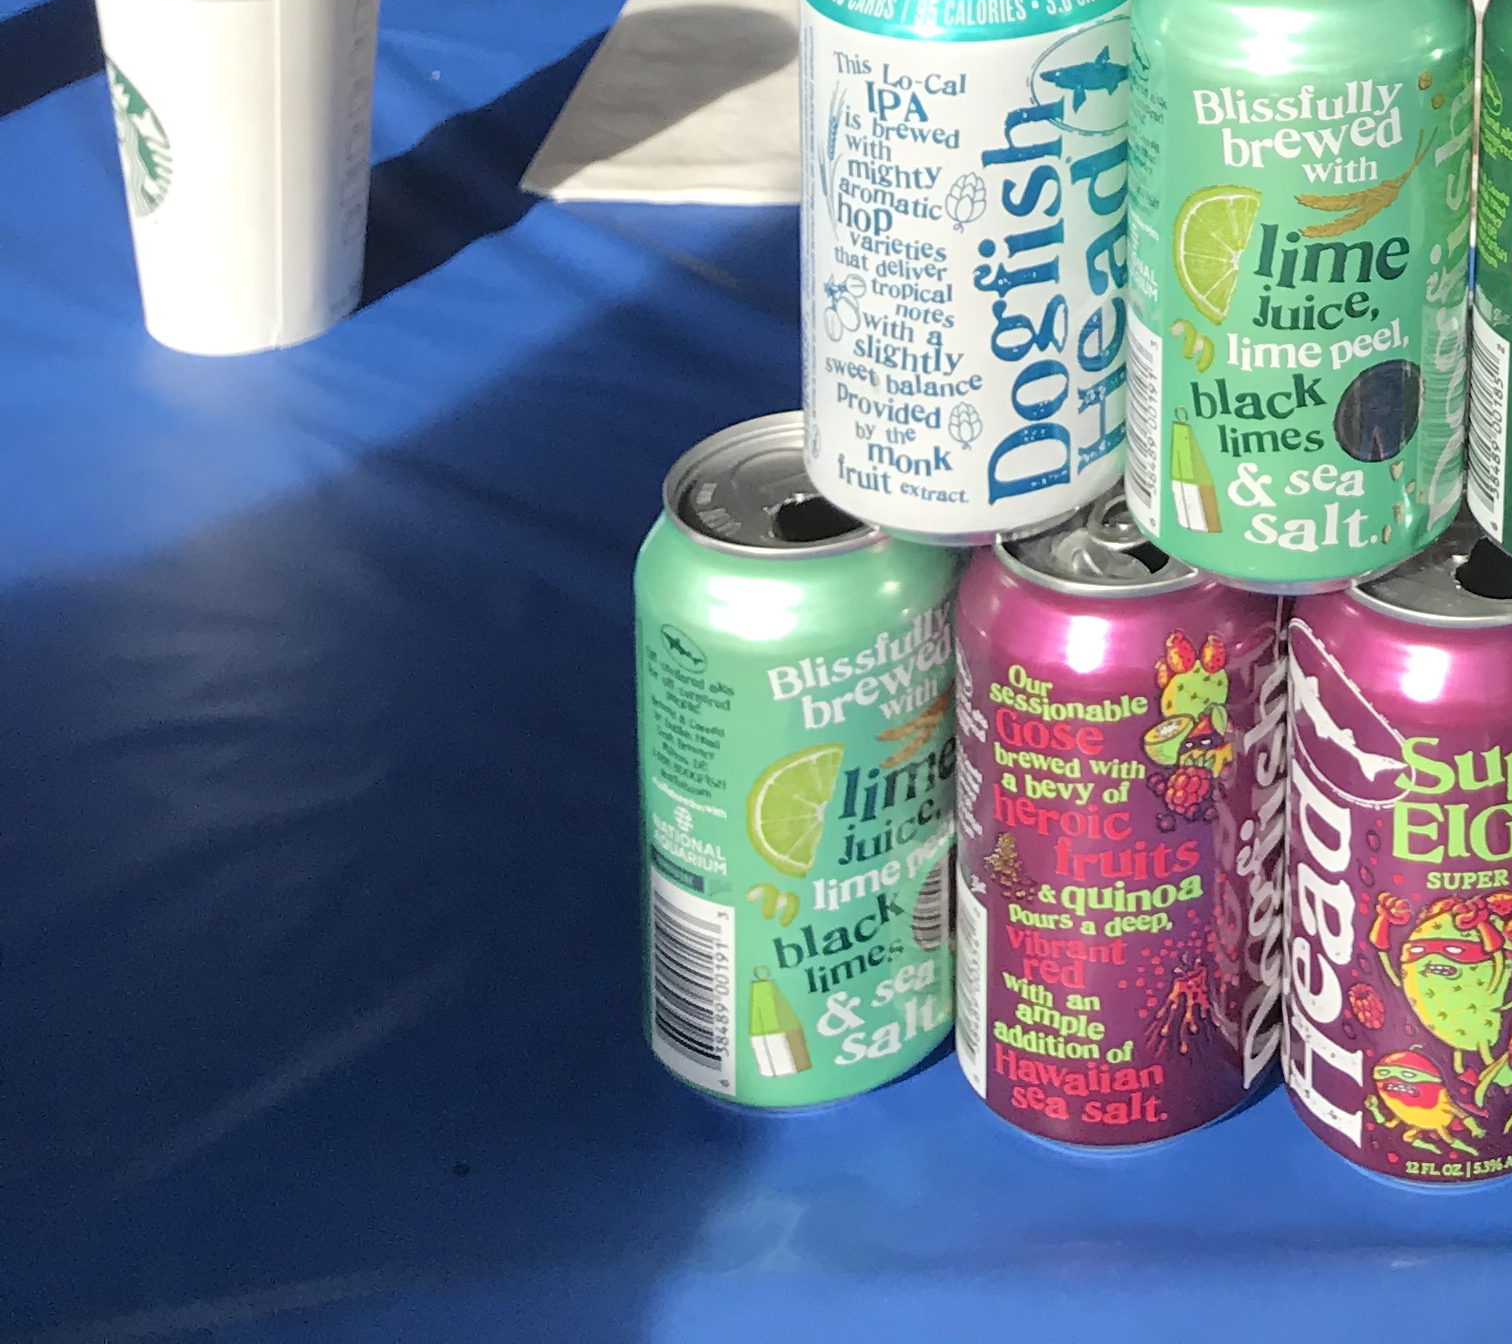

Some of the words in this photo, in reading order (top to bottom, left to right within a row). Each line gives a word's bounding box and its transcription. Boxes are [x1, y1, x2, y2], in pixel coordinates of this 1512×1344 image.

[917, 1, 938, 26] 95
[833, 51, 872, 75] This
[882, 63, 967, 96] Lo-Cal
[866, 80, 929, 123] IPA
[1192, 78, 1404, 126] Blissfully
[844, 133, 893, 162] with
[872, 117, 961, 150] brewed
[1222, 107, 1404, 169] brewed
[847, 159, 944, 191] mighty
[1301, 156, 1379, 185] with
[836, 196, 894, 242] hop
[838, 174, 943, 222] aromatic
[834, 245, 870, 273] that
[875, 259, 948, 283] deliver
[850, 229, 948, 263] varieties
[1253, 223, 1411, 290] lime
[871, 277, 954, 305] tropical
[972, 95, 1072, 506] Dogfish
[1252, 284, 1381, 332] juice,
[864, 312, 915, 343] with
[895, 302, 956, 329] notes
[853, 335, 966, 377] slightly
[1226, 332, 1322, 372] lime
[1329, 316, 1410, 370] peel,
[837, 381, 943, 431] provided
[886, 373, 984, 398] balance
[1190, 372, 1329, 422] black
[867, 442, 954, 478] monk
[1217, 423, 1325, 458] limes
[1227, 462, 1277, 509] &
[1284, 463, 1366, 498] sea
[1244, 501, 1379, 553] salt.
[1008, 665, 1053, 697] Our
[989, 681, 1149, 724] sessionable
[995, 708, 1105, 755] Gose
[993, 740, 1081, 779] brewed
[1089, 756, 1146, 780] with
[1025, 773, 1095, 806] bevy
[993, 784, 1133, 842] heroic
[1054, 837, 1201, 882] fruits
[1426, 868, 1510, 891] SUPER
[813, 860, 901, 911] lime
[1061, 874, 1203, 916] quinoa
[772, 891, 906, 970] black
[1022, 954, 1086, 989] red
[816, 990, 866, 1038] &
[870, 958, 935, 1007] sea
[993, 1021, 1100, 1060] addition
[1015, 1002, 1106, 1041] ample
[994, 1043, 1166, 1098] Hawaiian
[1011, 1083, 1070, 1122] sea
